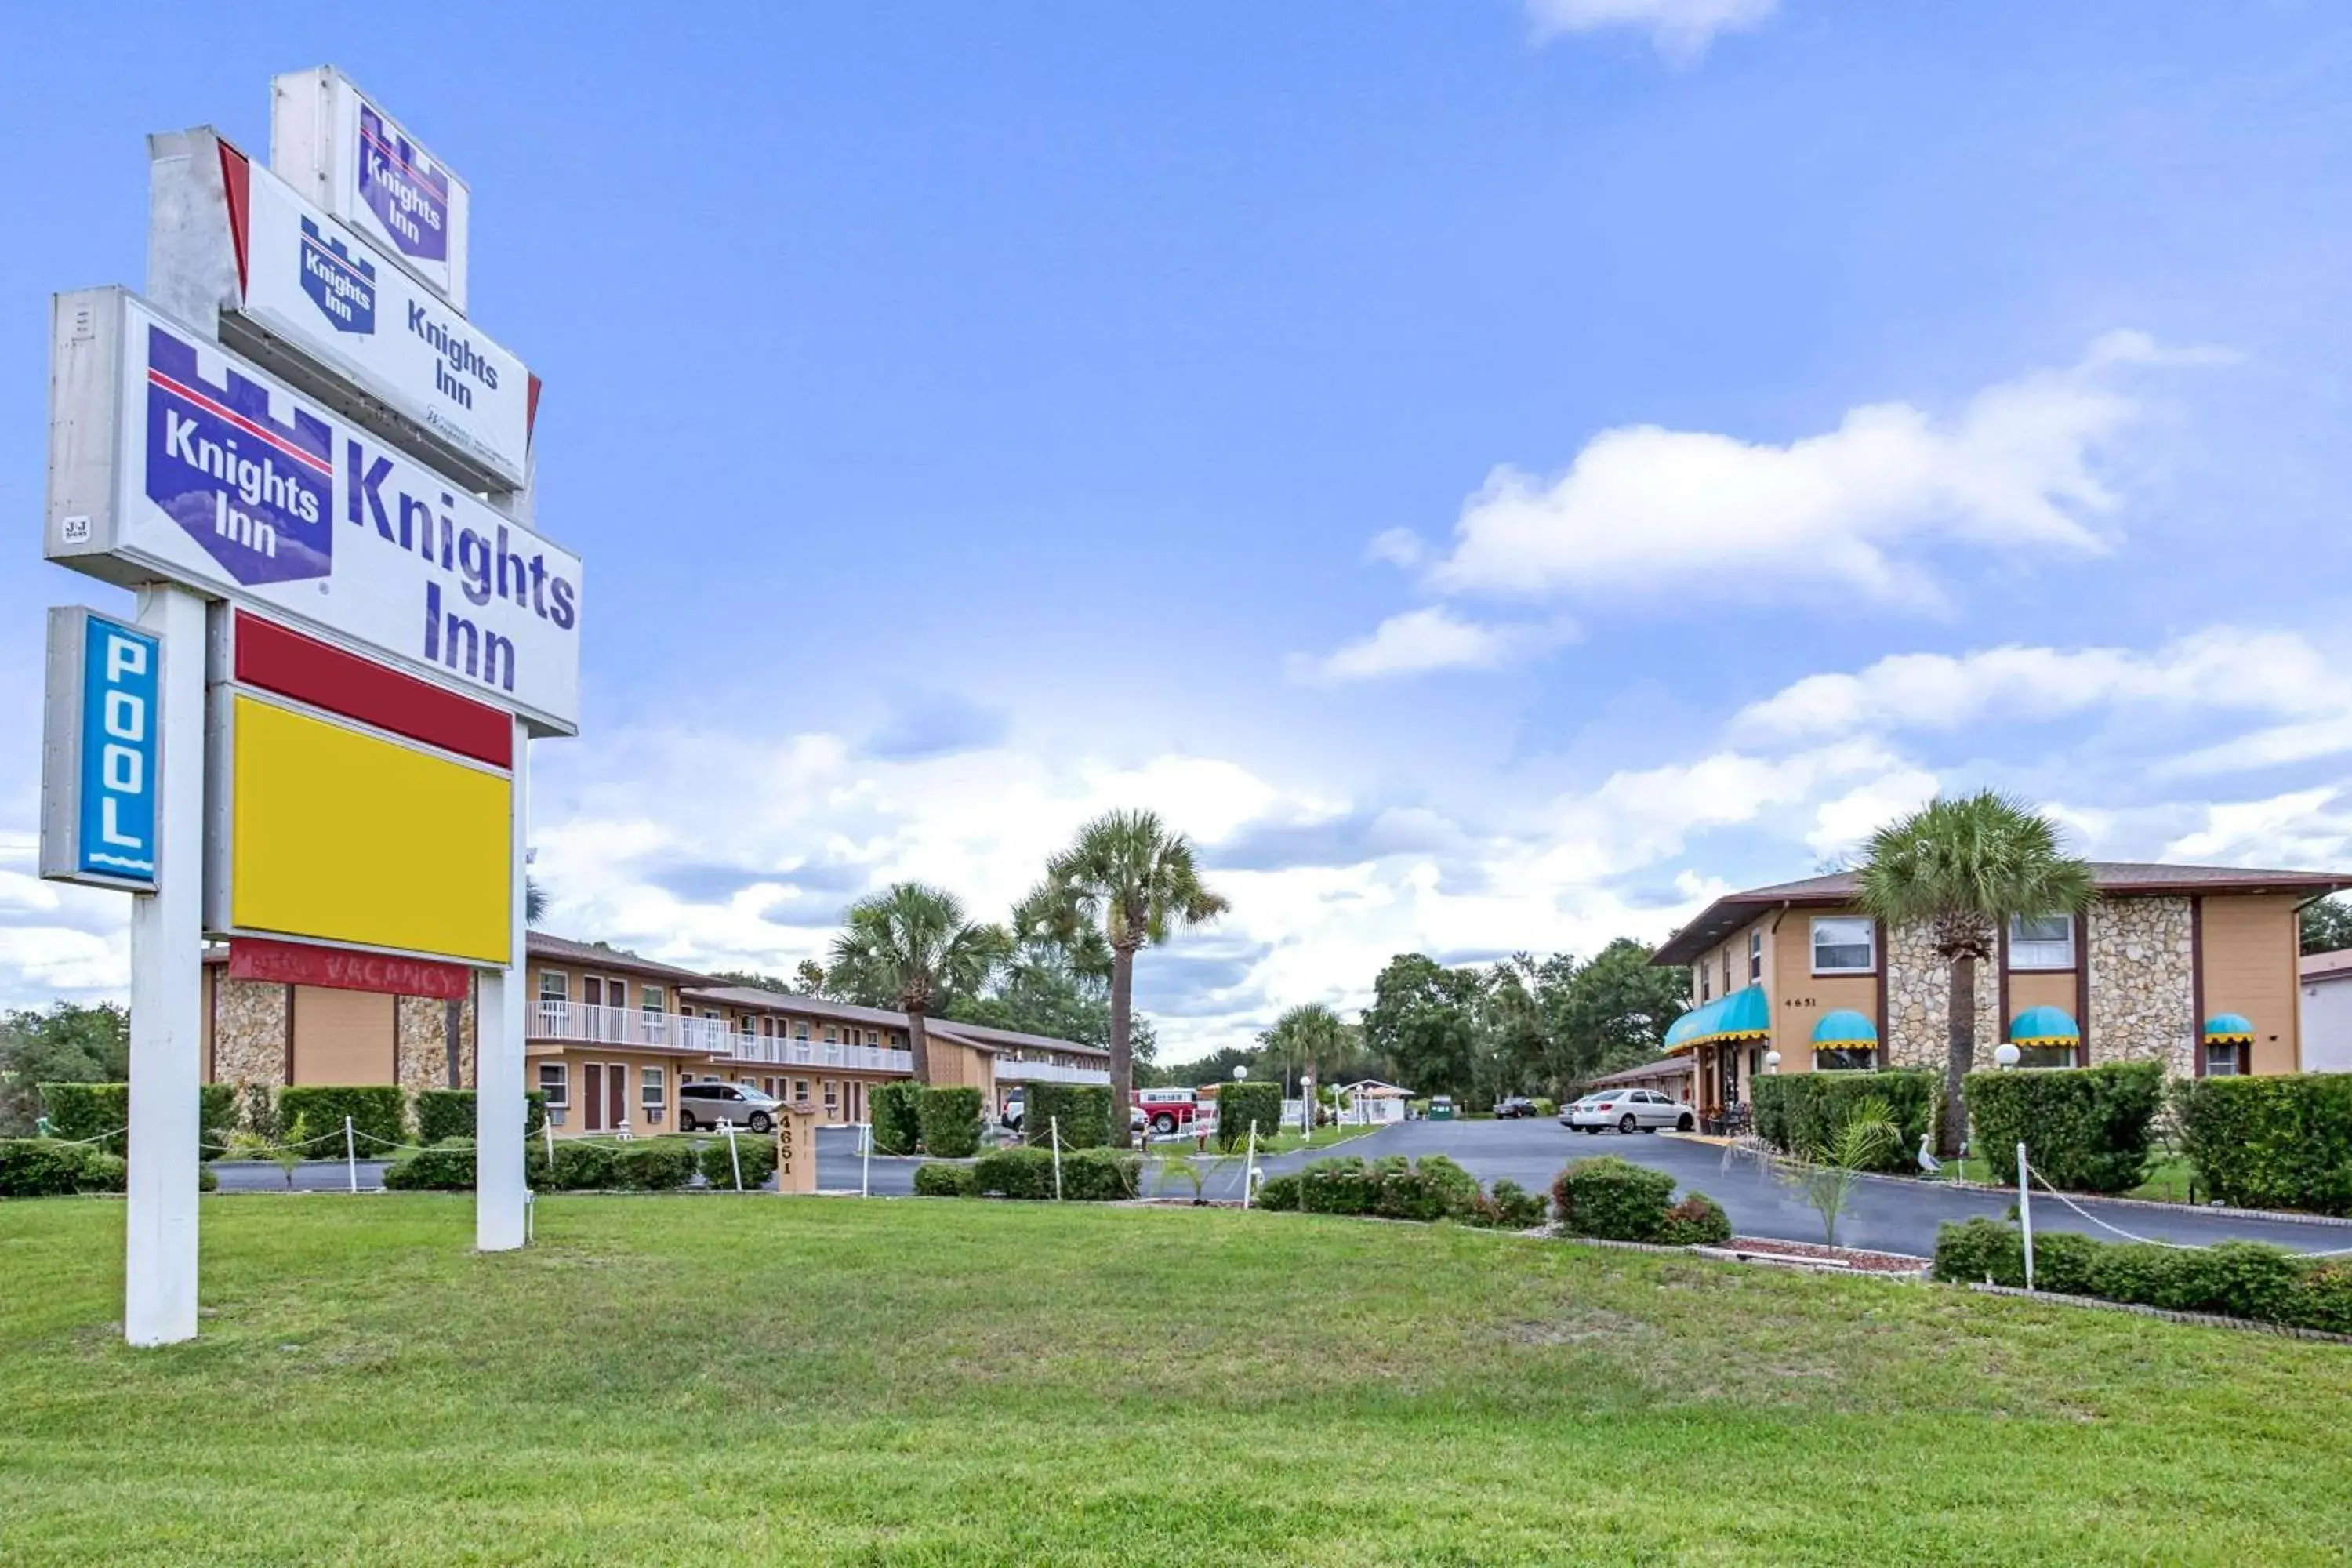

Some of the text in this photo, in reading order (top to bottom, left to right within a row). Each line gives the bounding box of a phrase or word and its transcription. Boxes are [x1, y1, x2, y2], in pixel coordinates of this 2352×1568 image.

[368, 149, 441, 230] Knights
[390, 198, 419, 245] Inn
[307, 249, 370, 310] Knights
[325, 287, 351, 322] Inn
[408, 299, 498, 390] Knights
[437, 358, 472, 411] Inn
[166, 408, 320, 524] Knights
[216, 489, 275, 558] Inn
[348, 439, 575, 630] Knights
[424, 580, 514, 692] Inn
[103, 634, 147, 848] POOL
[325, 954, 452, 993] VACANCY
[1785, 998, 1816, 1008] 4651
[780, 1116, 792, 1174] 4651
